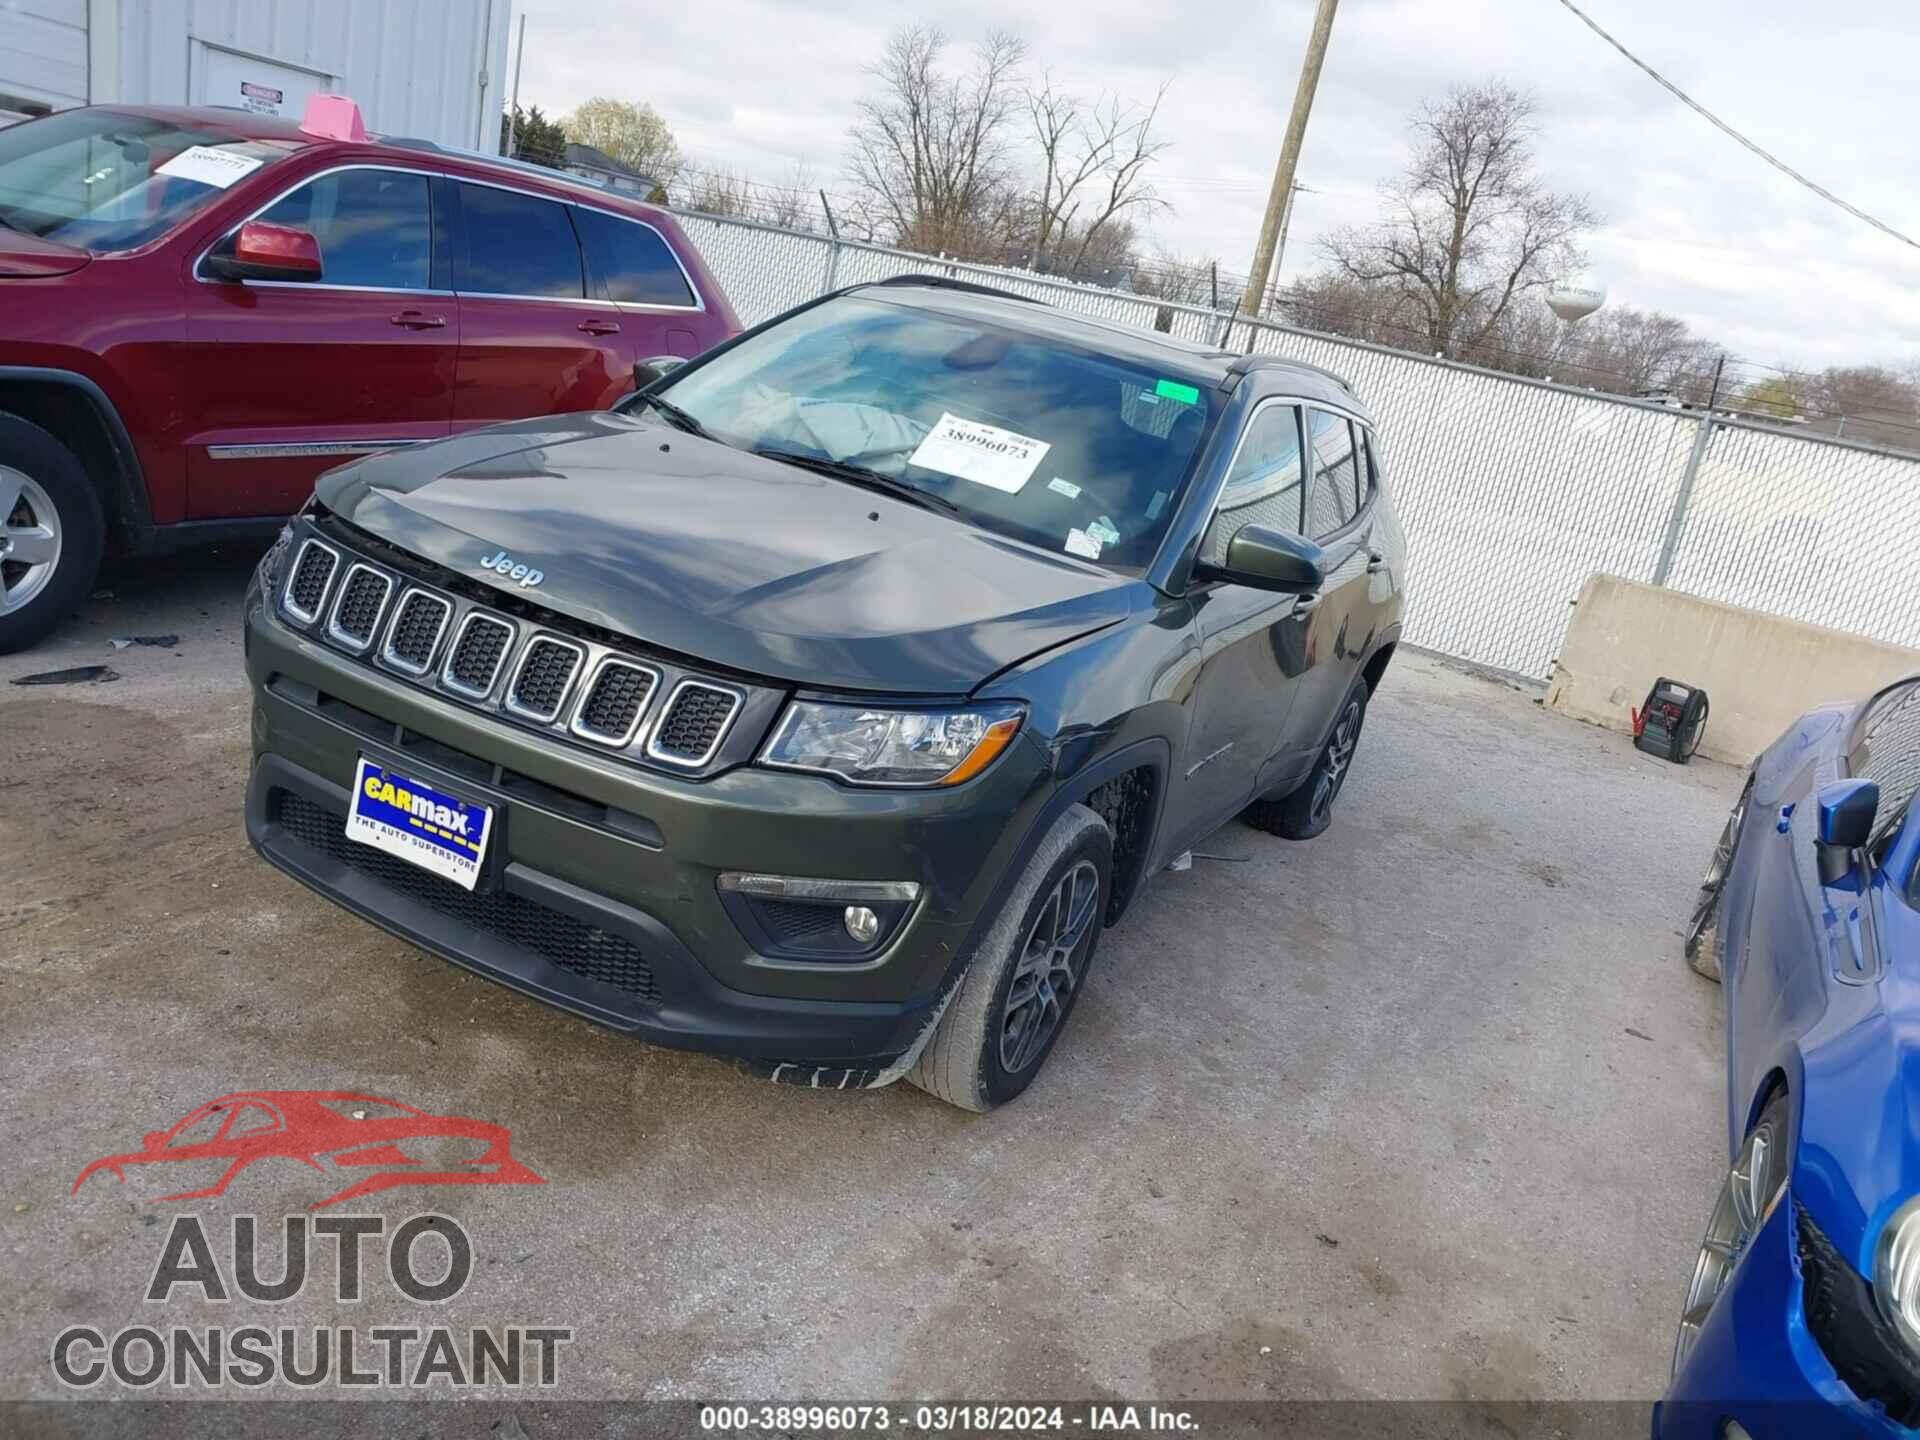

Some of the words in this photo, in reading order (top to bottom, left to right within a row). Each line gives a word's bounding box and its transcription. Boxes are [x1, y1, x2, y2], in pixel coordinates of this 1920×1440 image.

[942, 428, 1029, 459] 38996073
[480, 551, 544, 587] Jeep
[355, 816, 376, 830] THE
[381, 825, 407, 841] AUTO
[411, 838, 476, 873] SUPERSTORE
